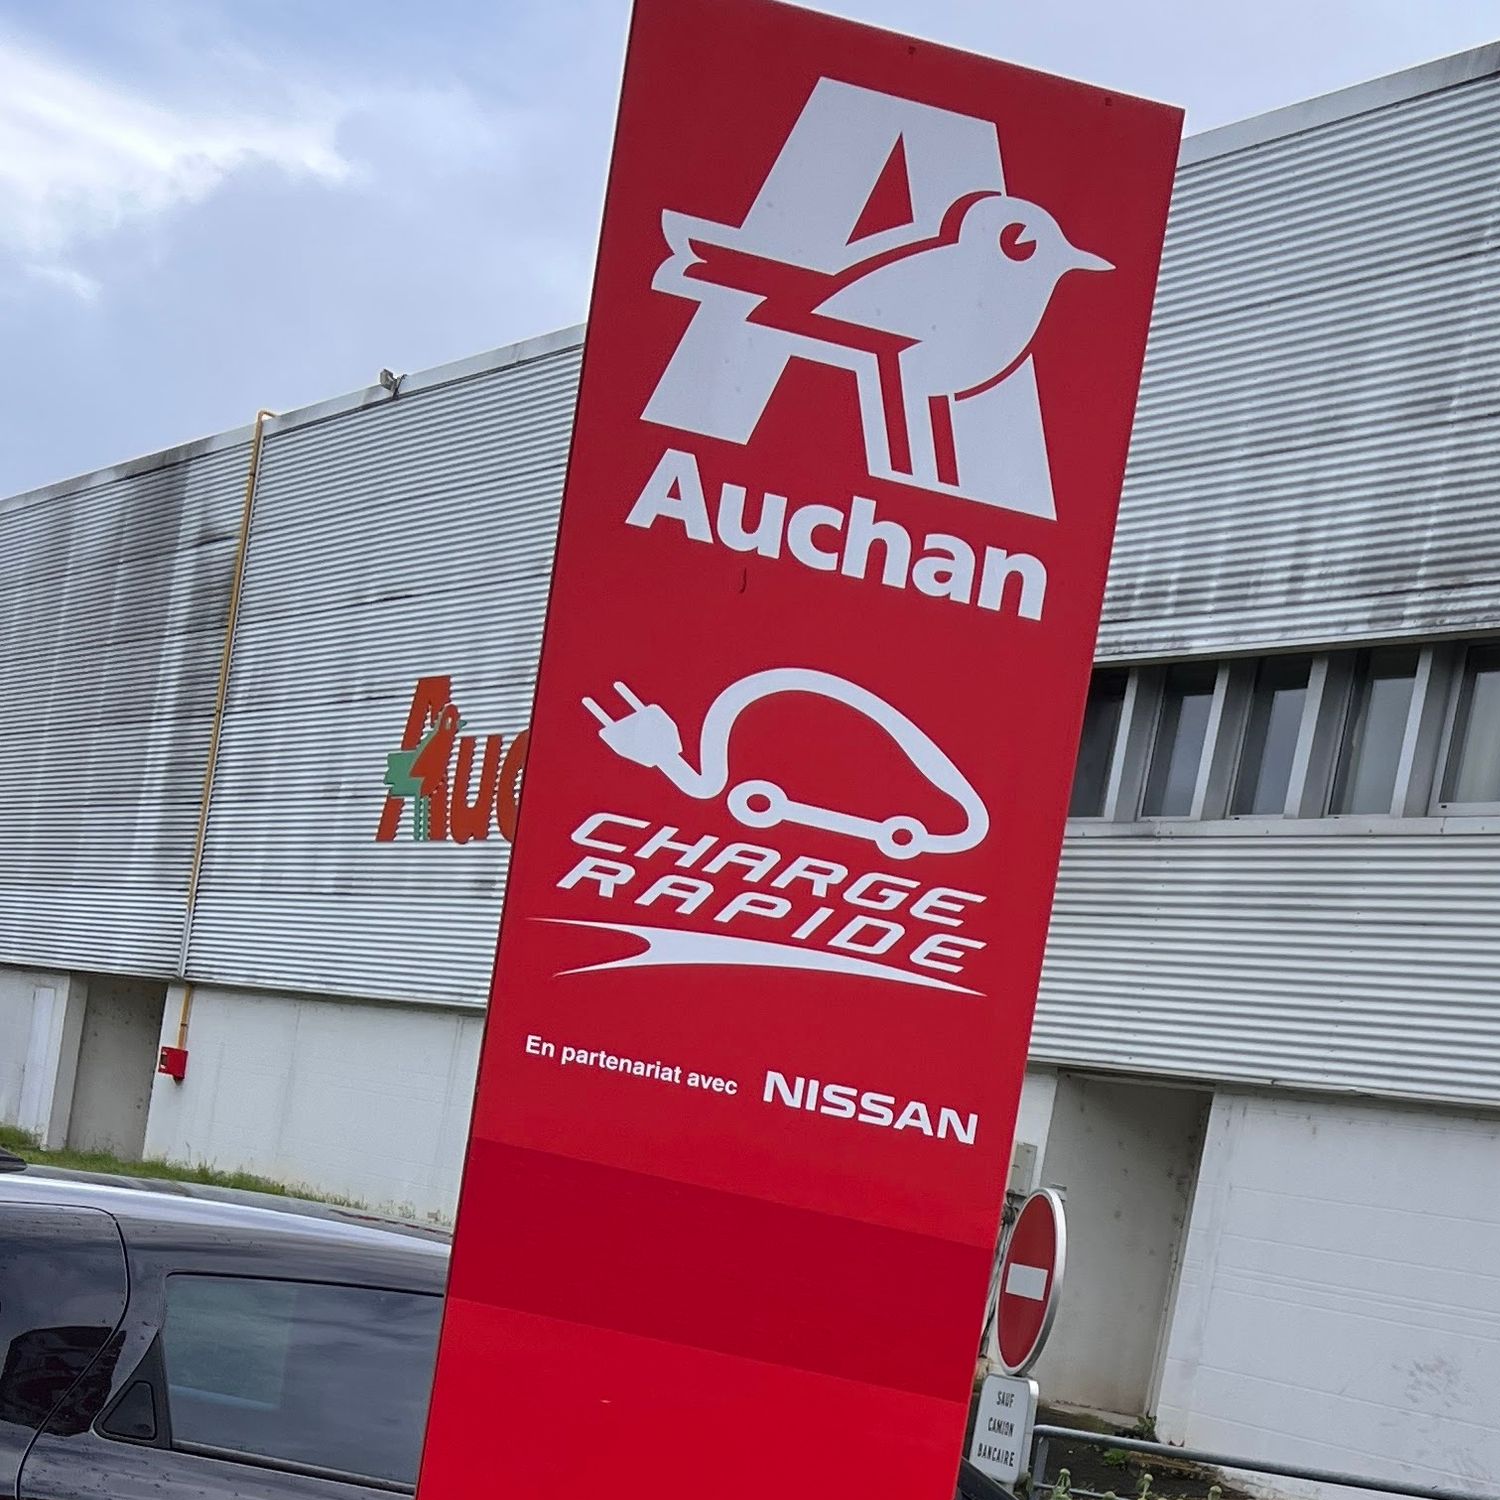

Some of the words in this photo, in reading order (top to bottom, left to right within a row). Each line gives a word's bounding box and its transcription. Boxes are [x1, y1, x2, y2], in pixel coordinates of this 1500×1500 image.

[625, 448, 1047, 621] Auchan
[556, 856, 988, 973] RAPIDE
[571, 812, 988, 927] CHARGE
[525, 1034, 555, 1058] En
[561, 1046, 682, 1083] partenariat
[686, 1072, 738, 1095] avec
[762, 1070, 979, 1145] NISSAN
[977, 1442, 1015, 1467] BANCAIRE
[987, 1416, 1015, 1437] CAMION
[996, 1390, 1015, 1408] SAUF
